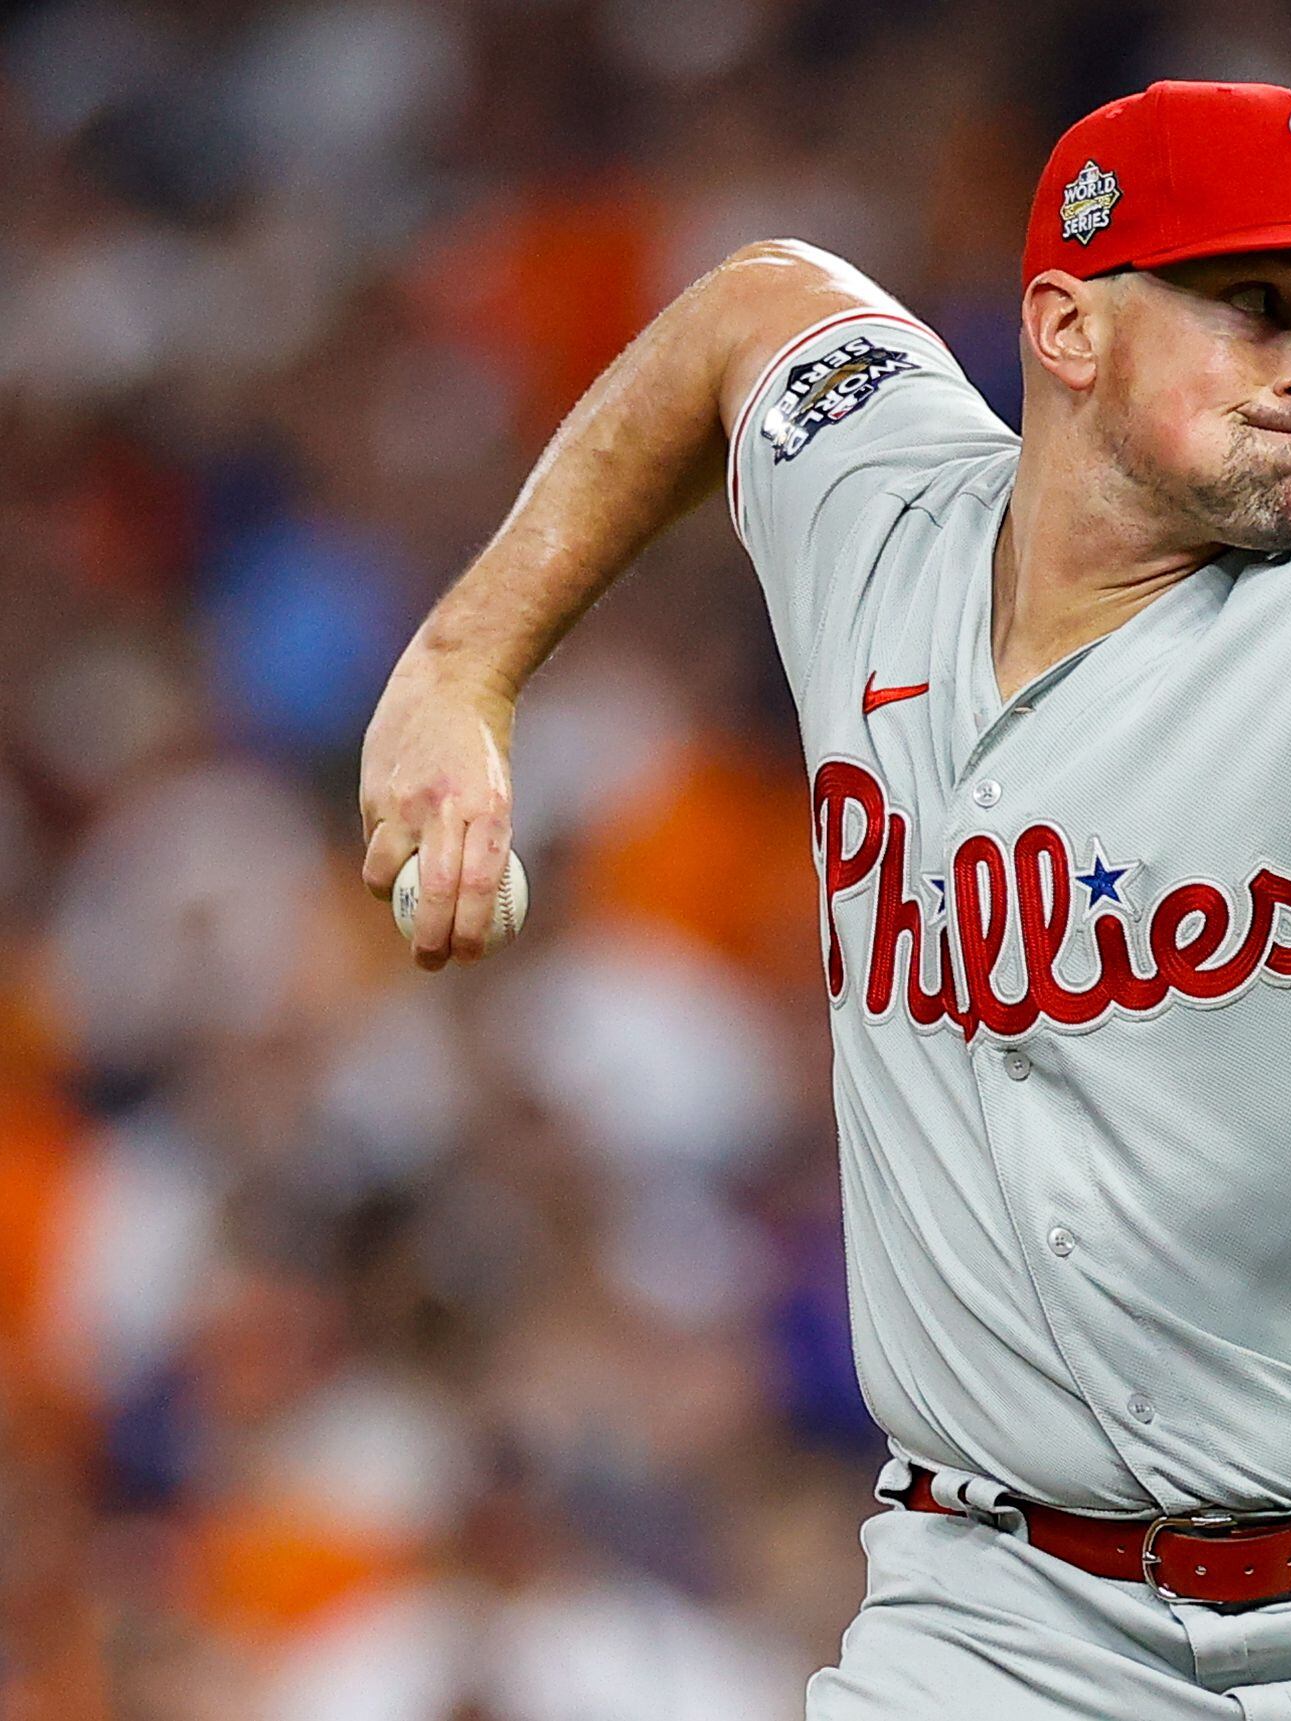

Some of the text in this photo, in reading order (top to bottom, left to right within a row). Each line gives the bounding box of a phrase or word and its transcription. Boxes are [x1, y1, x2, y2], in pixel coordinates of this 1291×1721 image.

[1064, 176, 1116, 204] WORLD
[1062, 209, 1110, 238] SERIES
[764, 338, 871, 434] SERIE
[786, 358, 915, 456] WORLD
